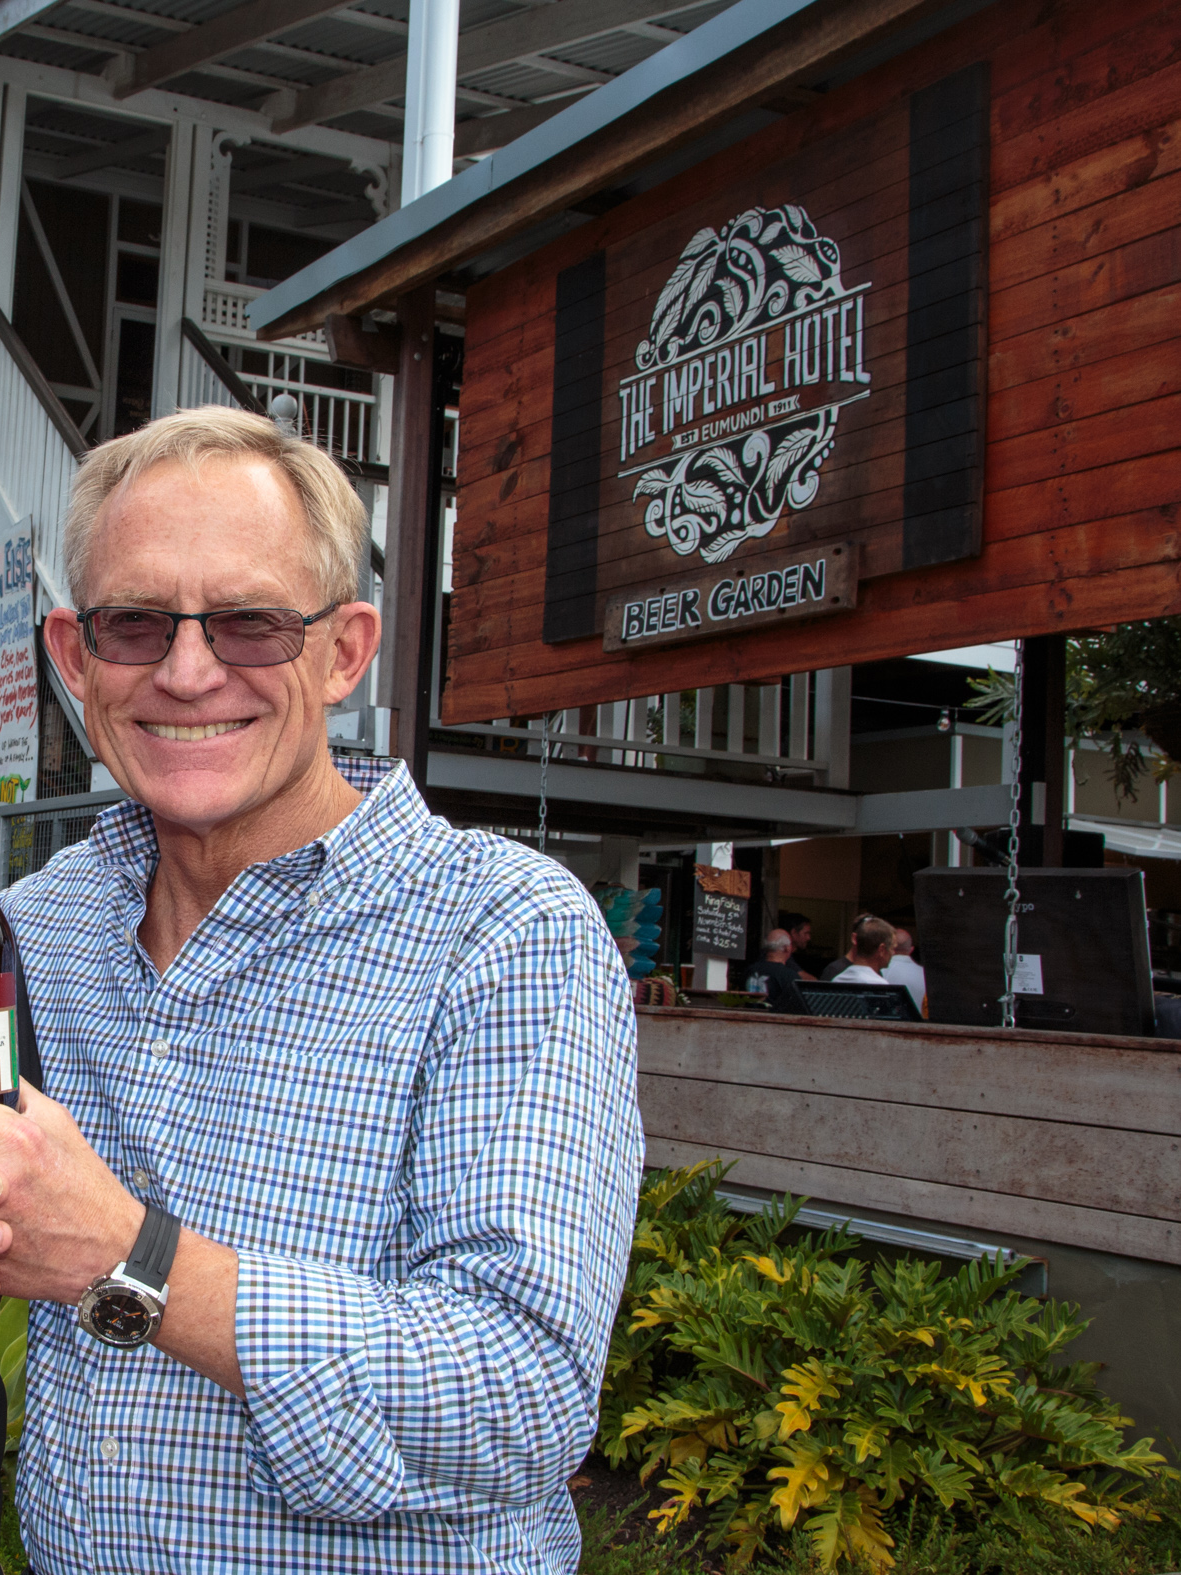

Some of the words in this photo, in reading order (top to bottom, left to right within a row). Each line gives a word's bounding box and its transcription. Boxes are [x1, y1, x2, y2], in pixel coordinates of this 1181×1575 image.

[619, 376, 657, 462] THE
[662, 332, 776, 435] IMPERIAL
[784, 295, 872, 389] HOTEL
[680, 431, 696, 445] EST
[701, 405, 765, 442] EUMUNDI
[772, 400, 793, 414] 1911
[621, 588, 703, 640] BEER
[707, 559, 827, 621] GARDEN
[0, 777, 19, 804] NOT
